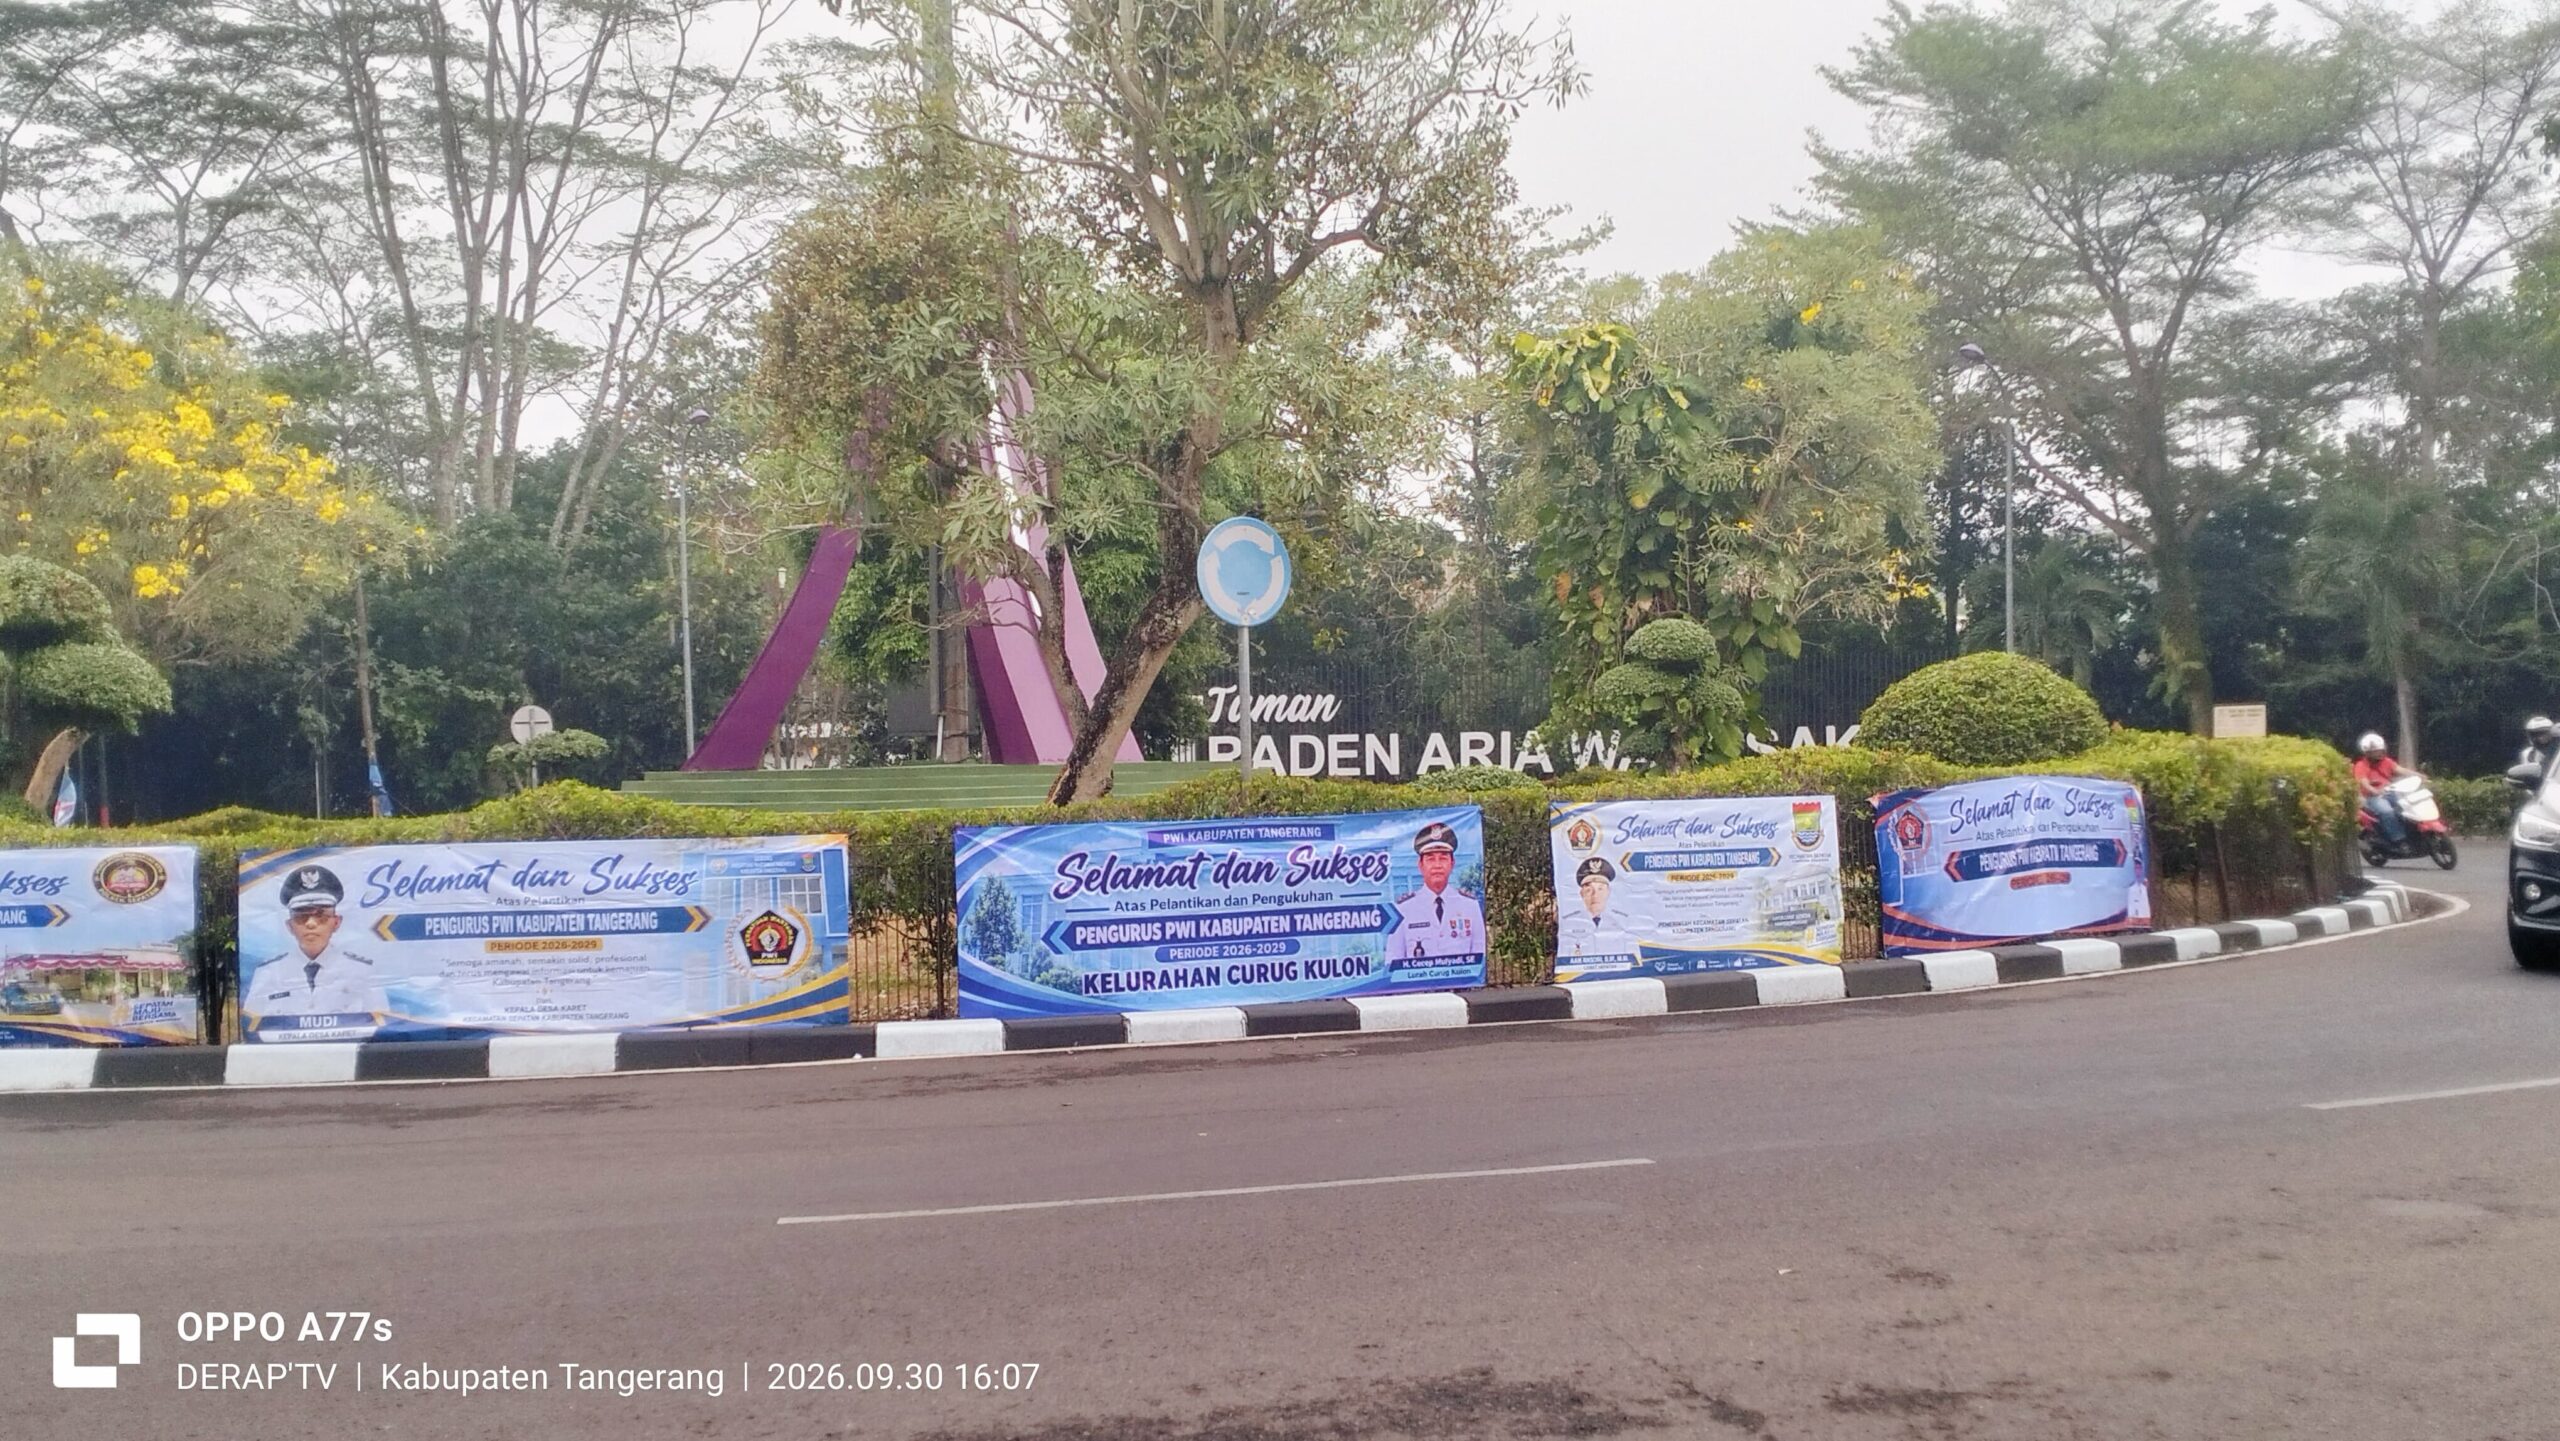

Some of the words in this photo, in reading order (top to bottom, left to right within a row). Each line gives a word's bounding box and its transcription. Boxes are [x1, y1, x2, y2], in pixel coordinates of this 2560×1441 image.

[1208, 685, 1342, 723] Taman
[1416, 730, 1554, 774] ARIA
[1949, 789, 2022, 835] Selamat
[2024, 787, 2055, 816] dan
[2064, 787, 2117, 820] Sukses
[1163, 833, 1184, 843] PWI
[1188, 829, 1254, 842] KABUPATEN
[1257, 827, 1321, 839] TANGERANG
[1612, 814, 1685, 845] Selamat
[1684, 817, 1715, 838] dan
[1720, 812, 1778, 840] Sukses
[1976, 831, 1994, 841] Atas
[1996, 825, 2035, 839] Pelantika
[2052, 821, 2099, 834] Pengukuhan
[1694, 840, 1725, 848] Pelantikan
[1644, 854, 1677, 869] PENGURUS
[1690, 852, 1725, 867] KABUPATEN
[1726, 851, 1760, 865] TANGERANG
[360, 859, 507, 908] Selamat
[511, 859, 575, 893] dan
[582, 854, 699, 896] Sukses
[1052, 851, 1212, 900] Selamat
[1212, 851, 1280, 889] dan
[1285, 845, 1388, 887] Sukses
[496, 897, 520, 906] Atas
[524, 896, 585, 906] Pelantikan
[1114, 901, 1146, 912] Atas
[1150, 897, 1221, 911] Pelantikan
[1224, 895, 1248, 907] dan
[1252, 891, 1333, 907] Pengukuhan
[425, 916, 489, 935] PENGURUS
[492, 915, 513, 933] PWI
[516, 913, 584, 932] KABUPATEN
[587, 912, 658, 930] TANGERANG
[1075, 923, 1162, 945] PENGURUS
[1165, 920, 1196, 940] PWI
[1200, 914, 1290, 938] KABUPATEN
[1294, 909, 1381, 931] TANGERANG
[490, 941, 539, 951] PERIODE
[541, 940, 598, 950] 2026-2029
[1170, 946, 1219, 960] PERIODE
[1223, 942, 1286, 957] 2026-2029
[595, 954, 647, 964] profesional
[1083, 966, 1221, 995] KELURAHAN
[1227, 961, 1298, 985] CURUG
[1304, 956, 1370, 980] KULON
[1407, 970, 1427, 979] Lurah
[1429, 969, 1450, 978] Curug
[1451, 968, 1472, 976] Kulon
[299, 1015, 338, 1028] MUDI
[586, 1012, 630, 1020] TANGERANG
